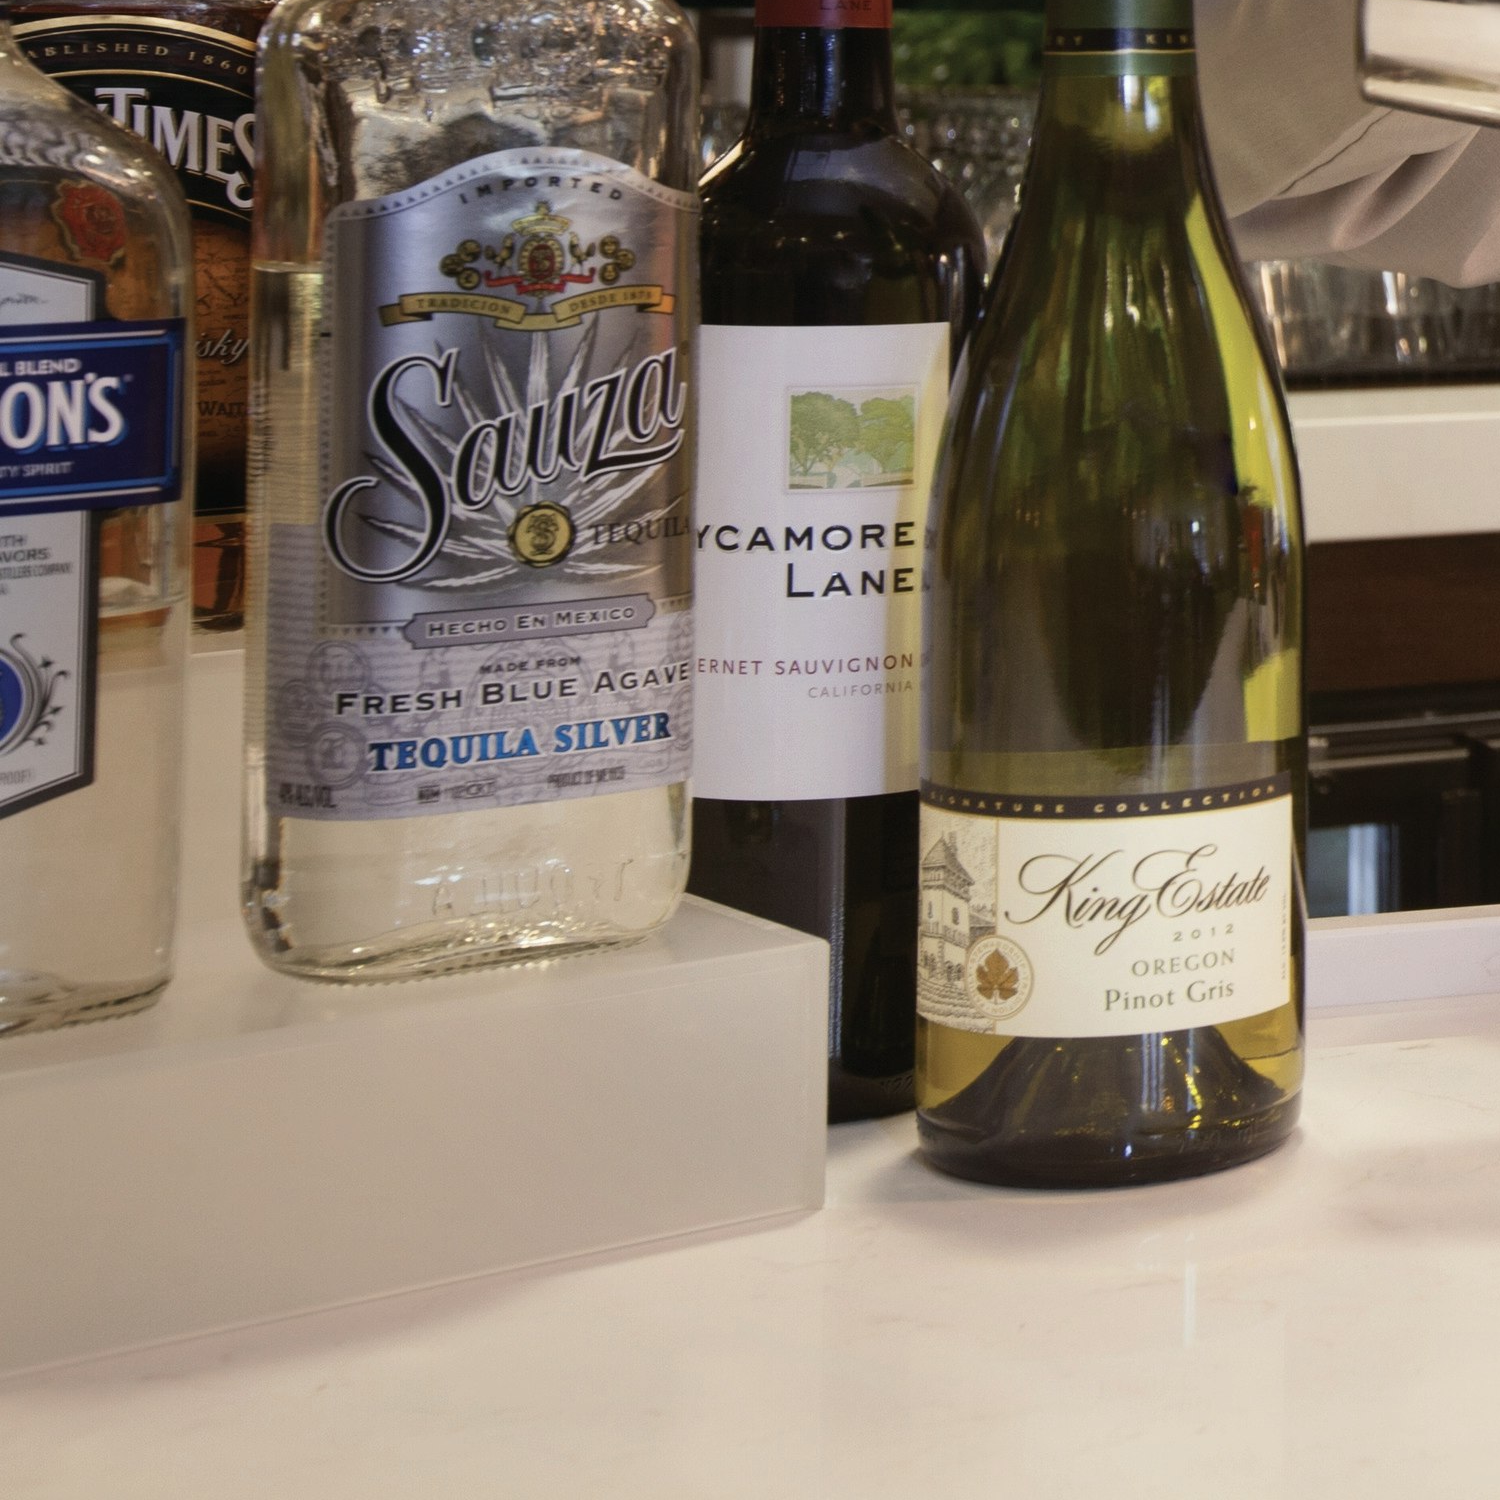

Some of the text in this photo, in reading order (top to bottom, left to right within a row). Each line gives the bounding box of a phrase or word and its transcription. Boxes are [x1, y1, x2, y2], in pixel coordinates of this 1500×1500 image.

[188, 51, 248, 76] 1860
[458, 175, 623, 204] IMPORTED
[569, 292, 617, 312] DESDE
[15, 358, 82, 376] BLEND
[322, 348, 688, 583] Sauza
[786, 562, 914, 598] LANE
[427, 606, 635, 638] HECHO EN MEXICO
[479, 654, 582, 675] MADE FROM
[775, 653, 913, 675] SAUVIGNON
[336, 662, 690, 716] FRESH BLUE AGAVE
[808, 680, 913, 698] CALIFORNIA
[368, 711, 672, 772] TEQUILA SILVER
[929, 784, 1275, 813] SIGNATURE COLLECTION
[1004, 843, 1271, 956] King Estate
[1173, 923, 1235, 942] 2012
[1131, 947, 1236, 977] OREGON
[1105, 979, 1235, 1012] Pinot Gris
